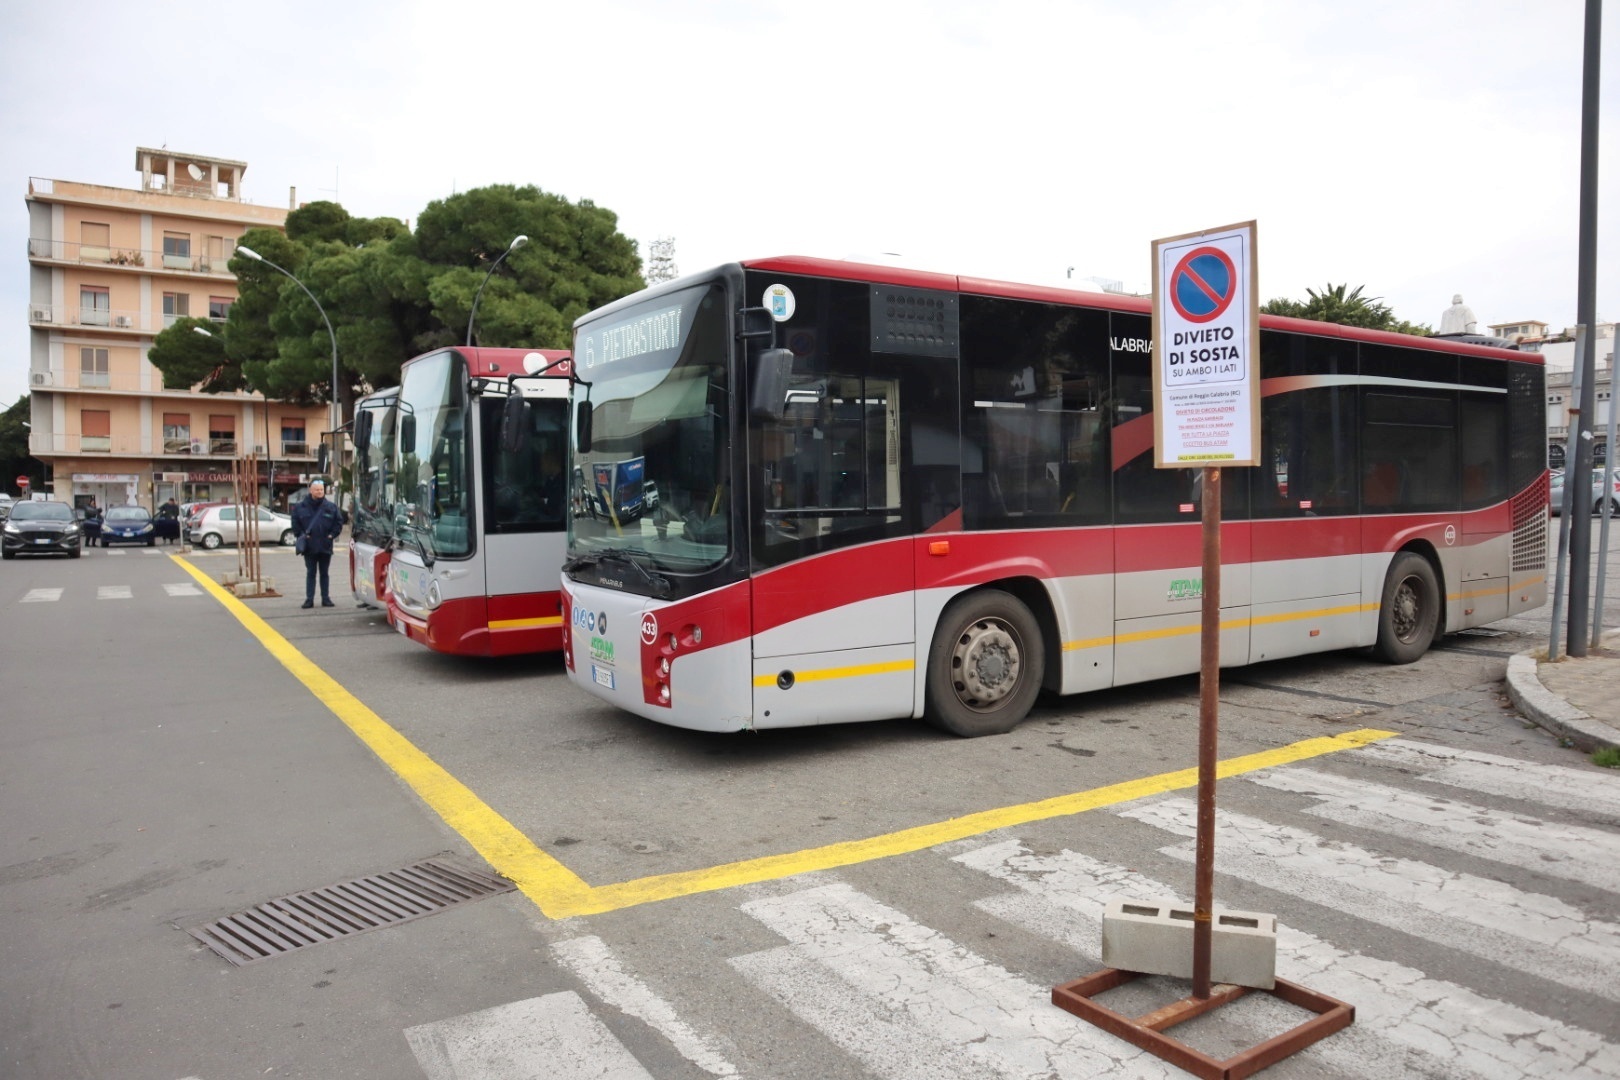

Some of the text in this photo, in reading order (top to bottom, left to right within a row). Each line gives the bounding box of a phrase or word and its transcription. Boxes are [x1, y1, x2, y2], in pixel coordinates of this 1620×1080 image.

[1174, 326, 1234, 346] DIVIETO
[586, 336, 595, 369] 6
[1169, 345, 1239, 366] DI SOSTA
[1172, 369, 1183, 378] SU
[1186, 366, 1212, 376] AMBO
[1220, 364, 1237, 373] LATI
[641, 621, 656, 636] 433
